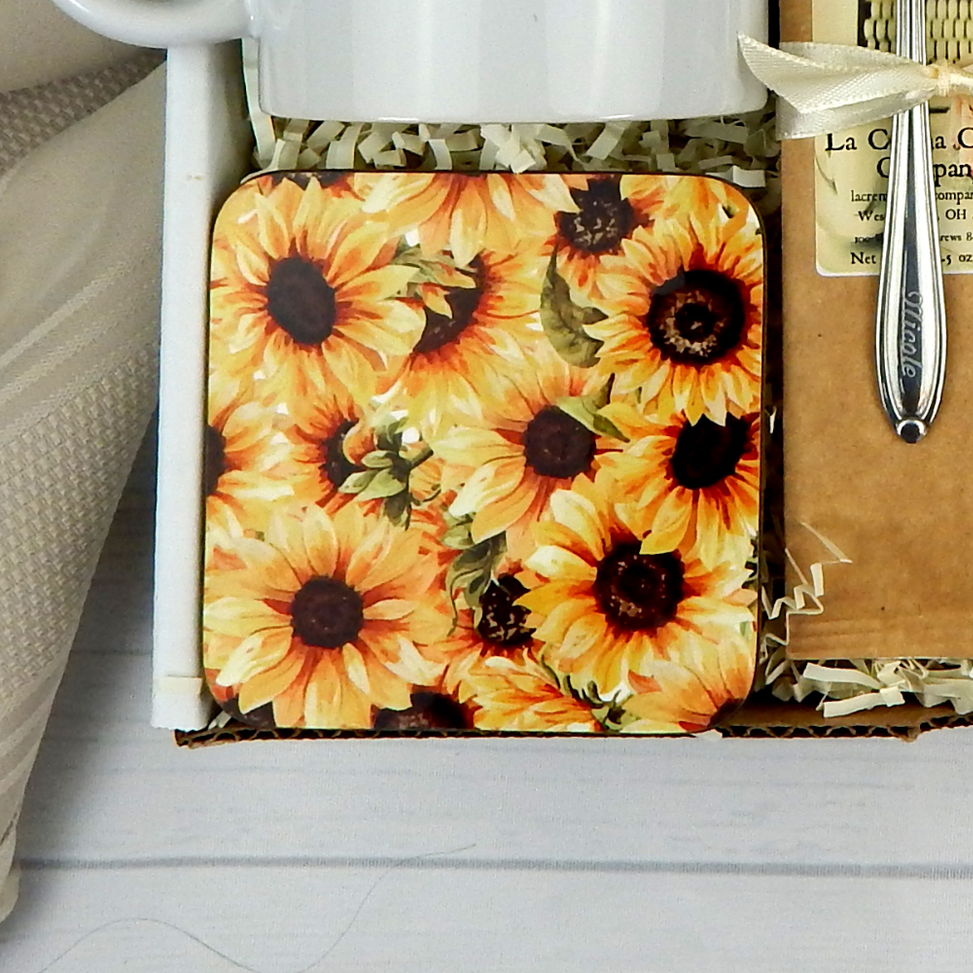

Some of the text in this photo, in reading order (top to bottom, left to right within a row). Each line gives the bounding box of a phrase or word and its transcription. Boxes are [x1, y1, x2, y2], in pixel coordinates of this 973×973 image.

[824, 132, 858, 152] La
[857, 210, 886, 223] Wes
[945, 208, 967, 221] OH
[939, 233, 962, 242] rews
[850, 251, 877, 265] Net
[901, 290, 925, 379] Nicole
